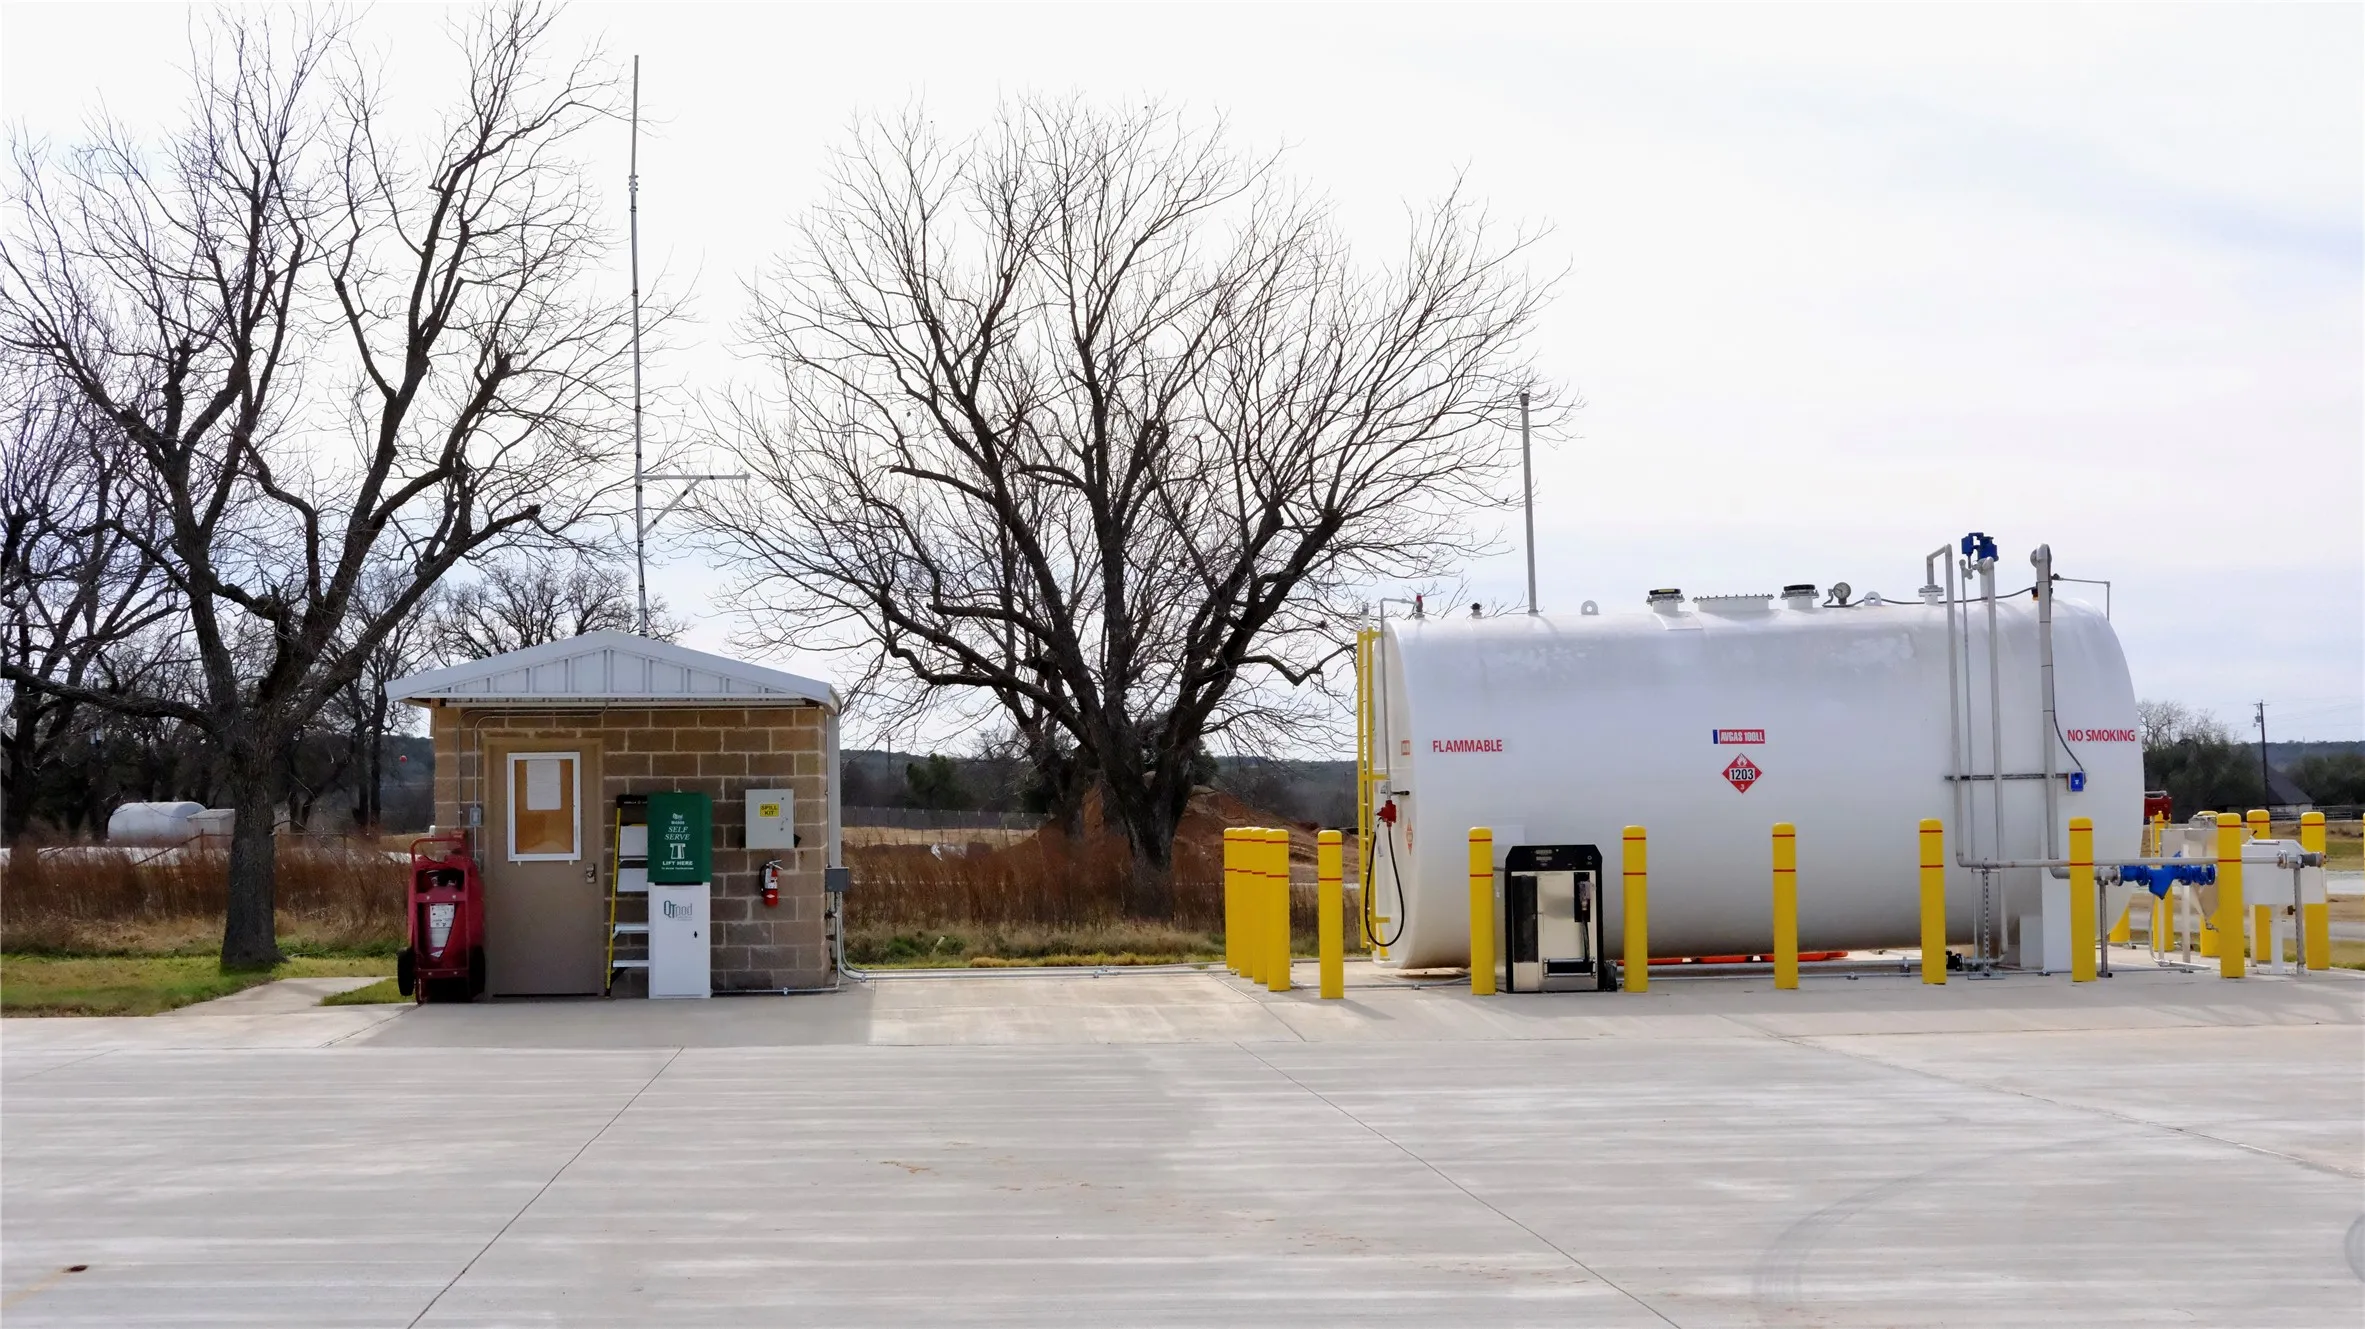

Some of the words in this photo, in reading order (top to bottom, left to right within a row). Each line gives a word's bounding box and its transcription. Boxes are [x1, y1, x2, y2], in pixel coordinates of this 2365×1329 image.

[1720, 732, 1742, 742] AVGAS
[1744, 732, 1764, 742] 100LL
[2067, 730, 2083, 741] NO
[2086, 730, 2135, 741] SMOKING
[1433, 740, 1503, 752] FLAMMABLE
[1730, 769, 1754, 780] 1203
